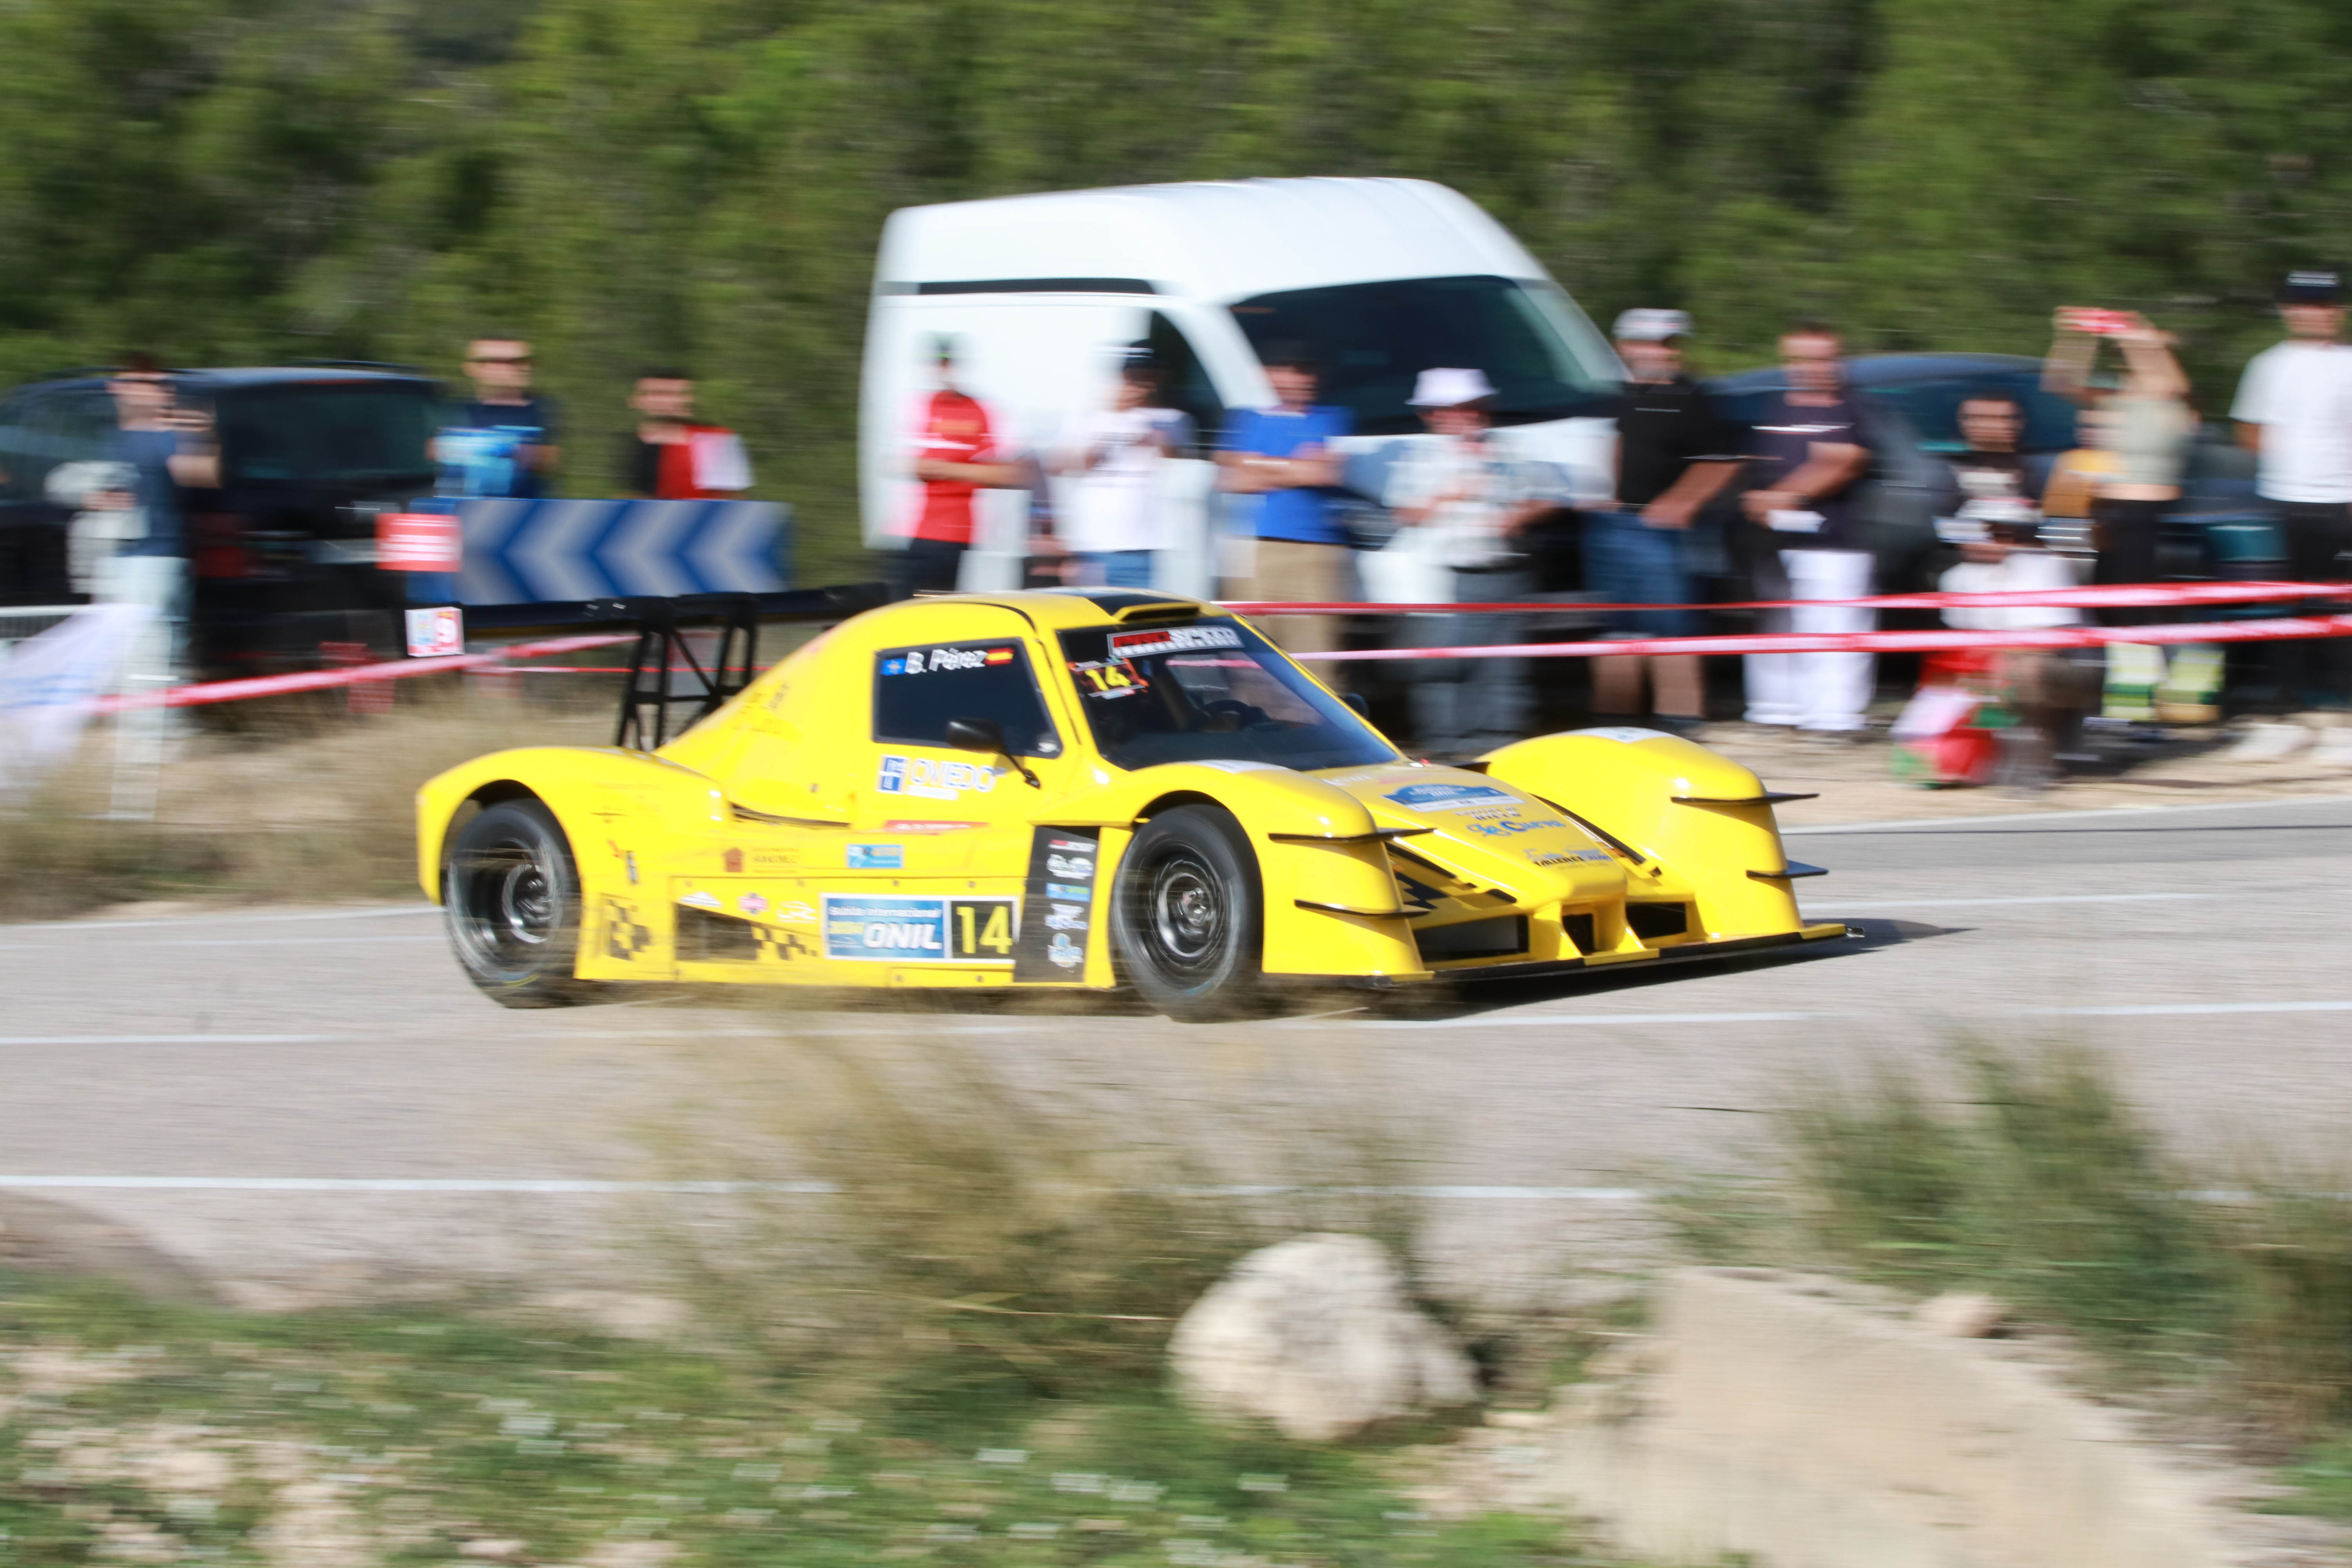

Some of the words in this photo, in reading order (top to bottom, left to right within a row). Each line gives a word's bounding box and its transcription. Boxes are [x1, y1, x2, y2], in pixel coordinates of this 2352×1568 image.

[905, 652, 927, 674] B.
[1085, 666, 1131, 691] 14
[863, 922, 942, 950] ONIL
[956, 906, 1013, 954] 14
